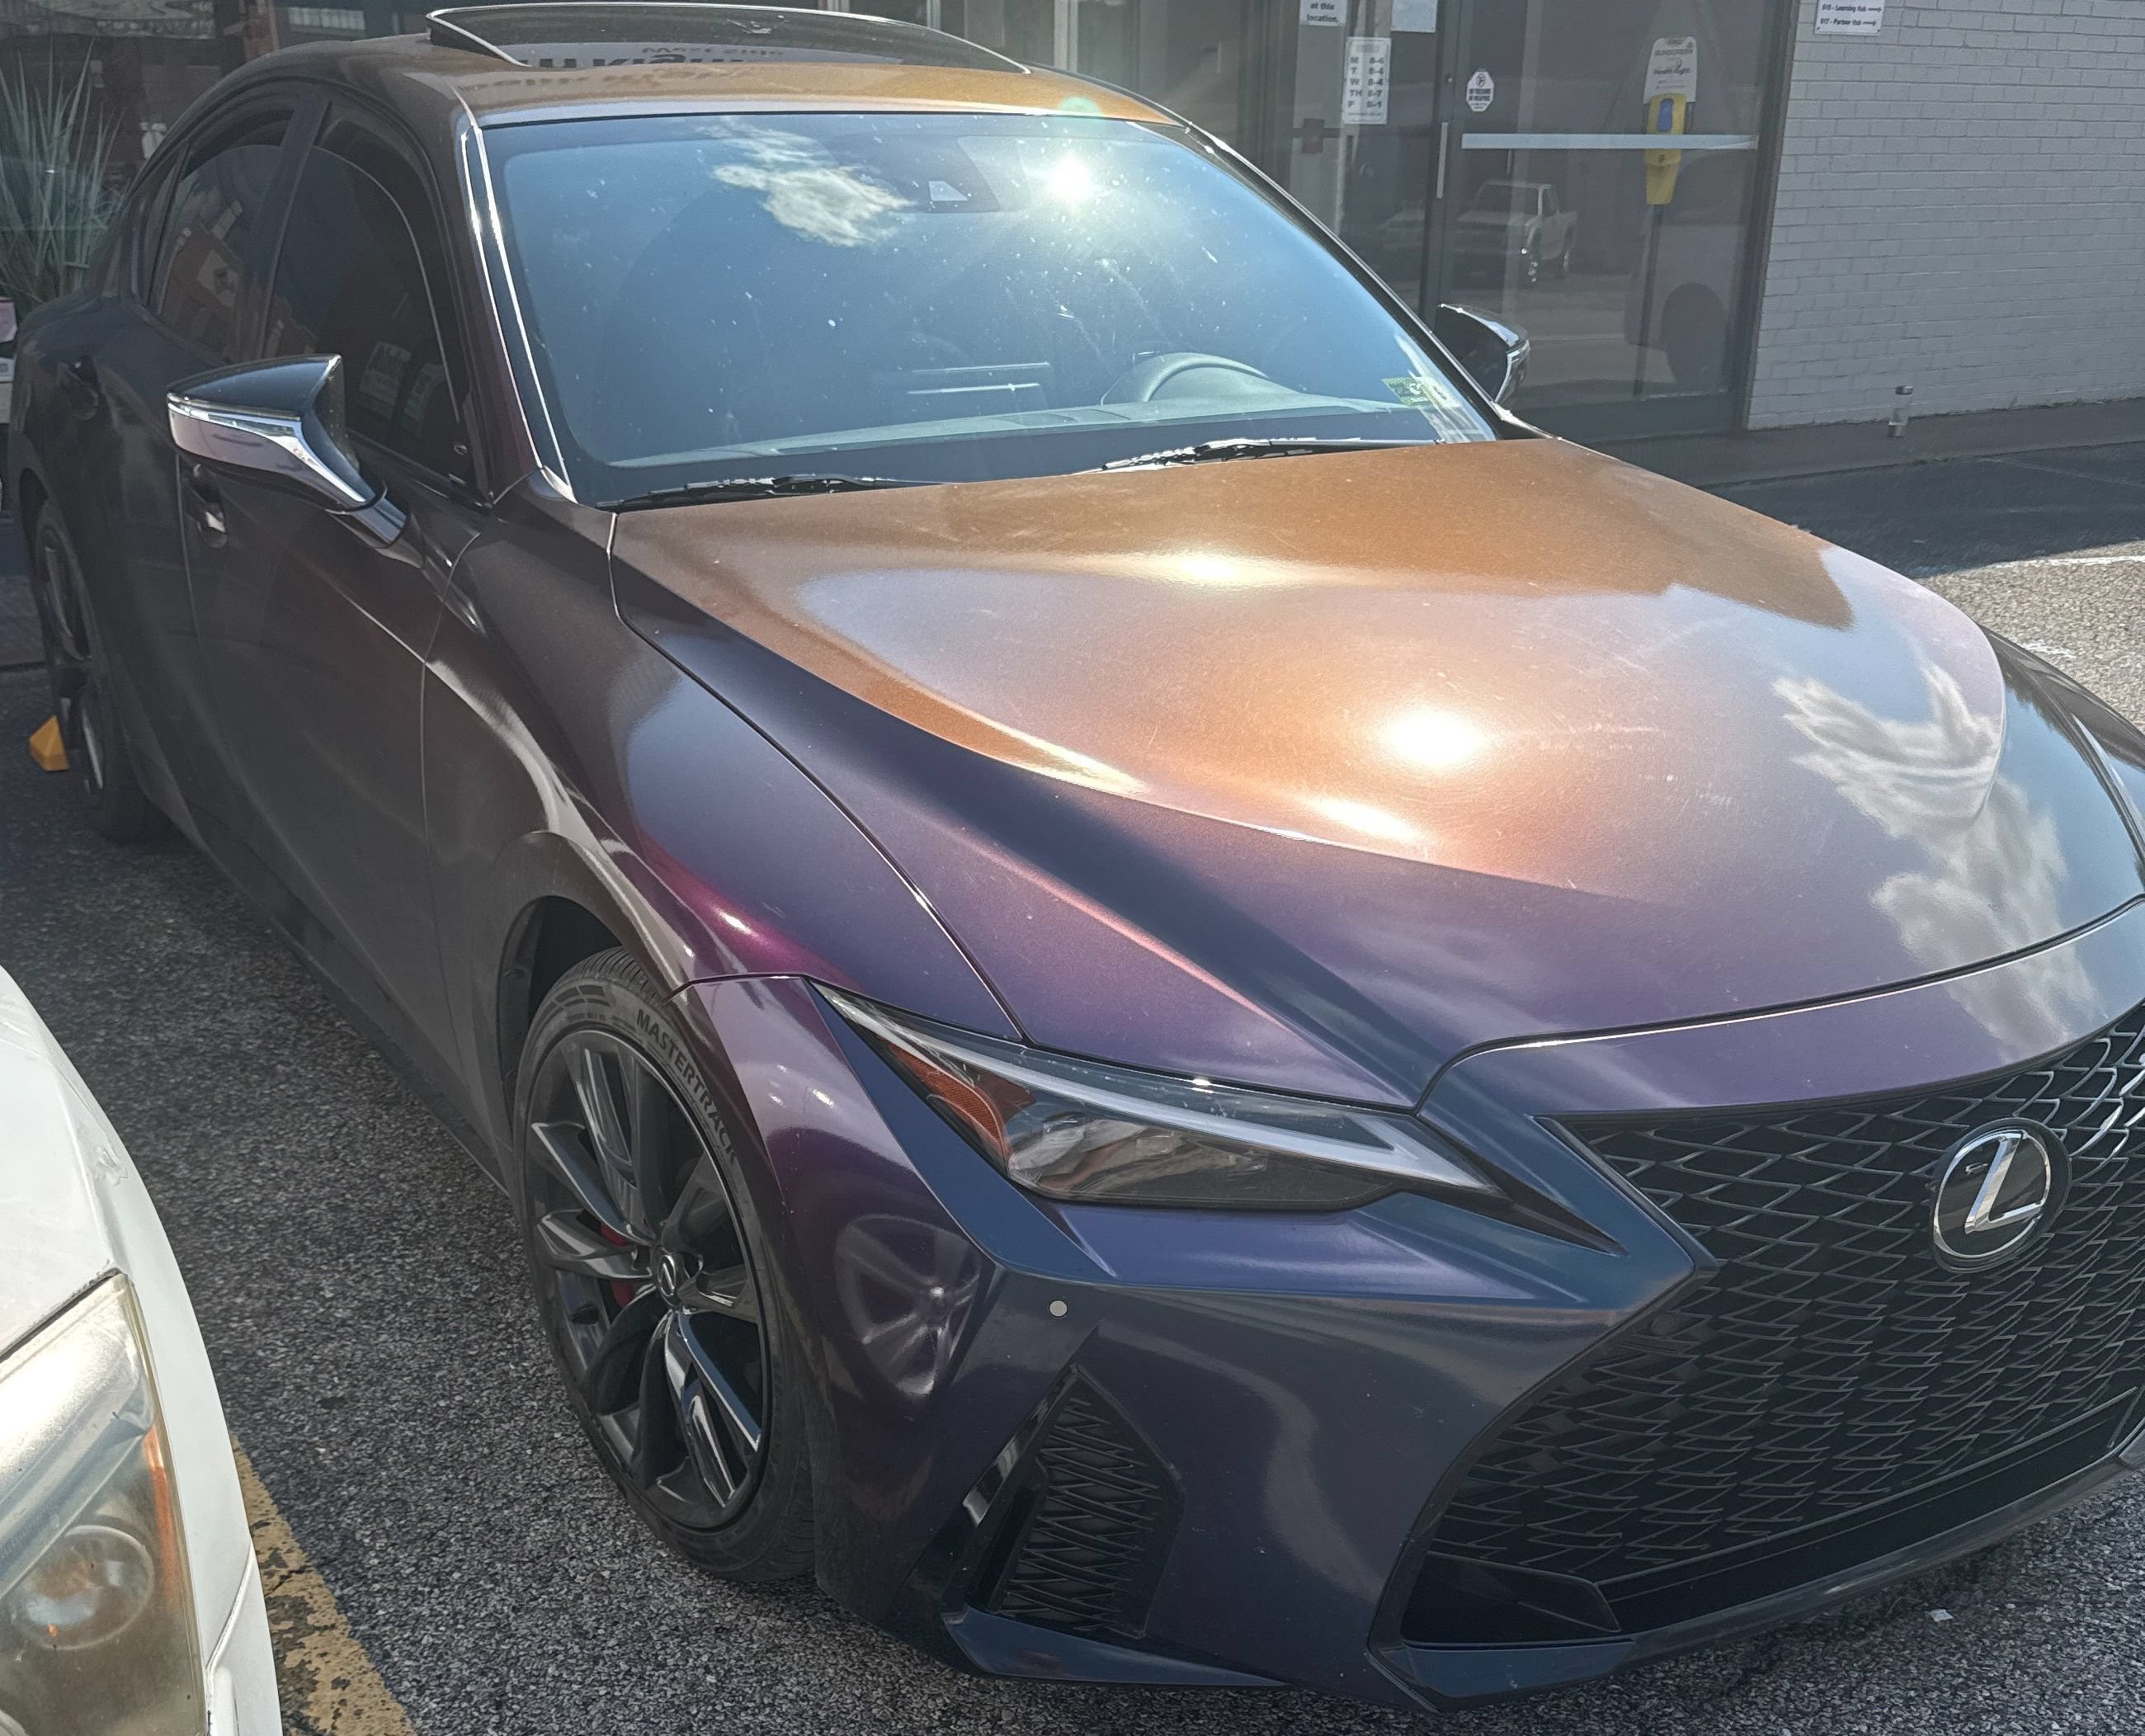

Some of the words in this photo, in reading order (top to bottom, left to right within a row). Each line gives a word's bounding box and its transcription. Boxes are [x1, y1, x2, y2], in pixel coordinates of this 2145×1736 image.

[1320, 2, 1335, 11] this
[1307, 13, 1339, 22] location.
[636, 1008, 735, 1164] MASTERTRACK
